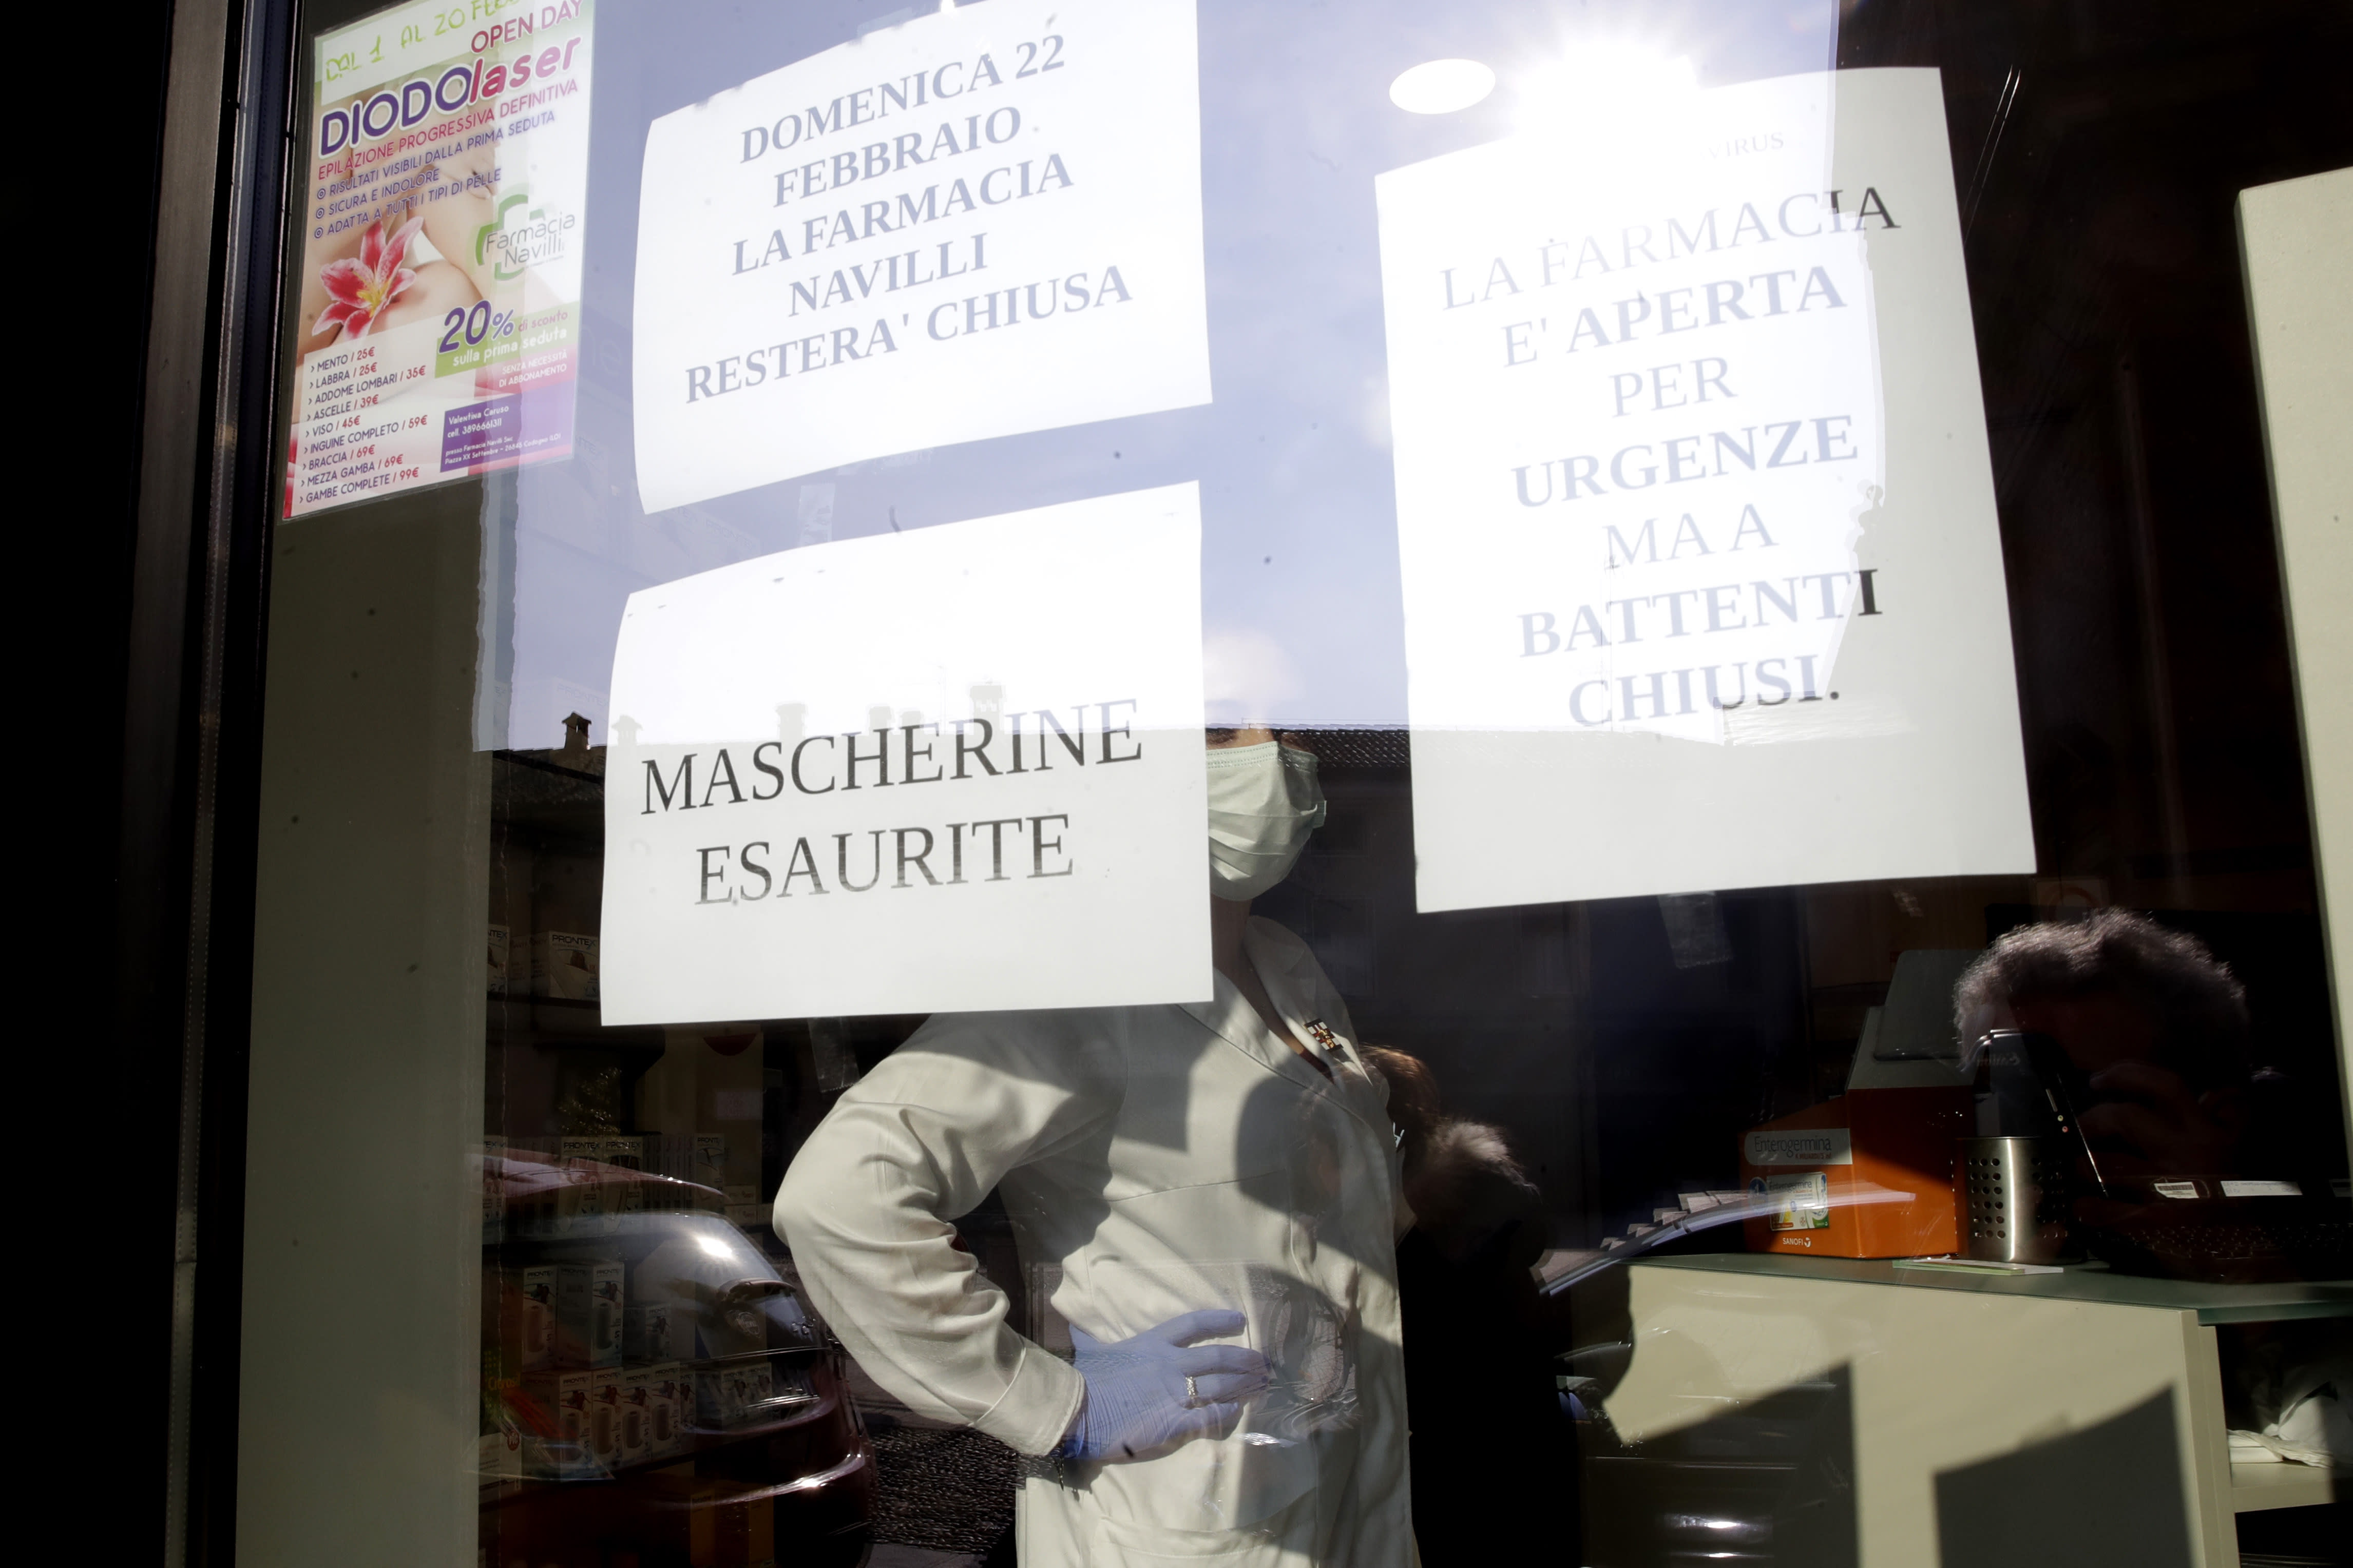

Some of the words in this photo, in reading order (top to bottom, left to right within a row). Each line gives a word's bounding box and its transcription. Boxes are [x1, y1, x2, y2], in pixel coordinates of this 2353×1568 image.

[369, 34, 385, 63] 1
[401, 25, 427, 49] AL
[471, 12, 533, 53] OPEN
[541, 0, 582, 29] DAY
[320, 36, 581, 156] DIODOlaser
[739, 53, 1004, 164] DOMENICA
[1014, 33, 1066, 81] 22
[318, 142, 394, 180] EPILAZIONE
[398, 108, 495, 152] PROGRESSIVA
[500, 79, 578, 118] DEFINITIVA
[1700, 131, 1785, 161] VIRUS
[329, 169, 379, 196] RISULTATI
[382, 155, 422, 177] VISIBILI
[425, 142, 463, 164] DALLA
[467, 128, 504, 150] PRIMA
[508, 110, 555, 137] SEDUTA
[772, 105, 1022, 208] FEBBRAIO
[327, 211, 369, 235] ADATTA
[373, 207, 381, 221] A
[386, 195, 417, 216] TUTTI
[428, 185, 448, 202] TIPI
[451, 181, 463, 196] DI
[466, 168, 502, 190] PELLE
[329, 193, 368, 216] SICURA
[371, 188, 378, 201] E
[381, 168, 439, 198] INDOLORE
[486, 211, 576, 253] Farmacia
[731, 228, 792, 276] LA
[801, 151, 1075, 255] FARMACIA
[505, 234, 562, 267] Navilli
[1439, 255, 1524, 311] LA
[1537, 186, 1902, 288] FARMACIA
[788, 232, 989, 317] NAVILLI
[438, 300, 514, 353] 20%
[518, 319, 528, 332] di
[531, 309, 568, 329] sconto
[684, 313, 910, 404] RESTERA'
[926, 263, 1134, 341] CHIUSA
[1501, 317, 1549, 369] E'
[1564, 265, 1848, 355] APERTA
[317, 354, 349, 372] MENTO
[356, 346, 375, 361] 25€
[453, 350, 480, 366] sulla
[484, 341, 518, 362] prima
[523, 326, 567, 349] seduta
[502, 361, 526, 375] SENZA
[528, 349, 567, 370] NECESSITÀ
[315, 383, 354, 404] ADDOME
[356, 372, 397, 393] LOMBARI
[406, 365, 426, 380] 35€
[316, 370, 350, 389] LABBRA
[359, 362, 378, 376] 25€
[499, 379, 506, 388] DI
[508, 363, 567, 385] ABBONAMENTO
[1608, 356, 1739, 419] PER
[312, 422, 334, 437] VISO
[342, 415, 360, 429] 45€
[313, 400, 352, 421] ASCELLE
[360, 394, 379, 409] 39€
[448, 411, 482, 425] Valentina
[483, 405, 509, 417] Caruso
[310, 435, 345, 454] INGUINE
[348, 422, 399, 443] COMPLETO
[408, 414, 428, 429] 59€
[446, 448, 463, 457] presso
[447, 428, 460, 438] cell.
[307, 470, 338, 487] MEZZA
[340, 461, 375, 478] GAMBA
[384, 453, 404, 468] 69€
[309, 451, 348, 471] BRACCIA
[356, 444, 375, 458] 69€
[445, 456, 462, 464] Piazza
[472, 448, 499, 459] Settembre
[1510, 415, 1859, 509] URGENZE
[305, 486, 338, 504] GAMBE
[340, 473, 390, 495] COMPLETE
[399, 467, 419, 481] 99€
[1601, 512, 1717, 569] MA
[1728, 502, 1780, 552] A
[1516, 568, 1883, 659] BATTENTI
[1568, 654, 1840, 728] CHIUSI.
[640, 697, 1143, 816] MASCHERINE
[694, 812, 1075, 906] ESAURITE
[487, 930, 507, 940] NTEX
[552, 934, 597, 950] PRONTEX
[1754, 1135, 1832, 1158] Enterogermina
